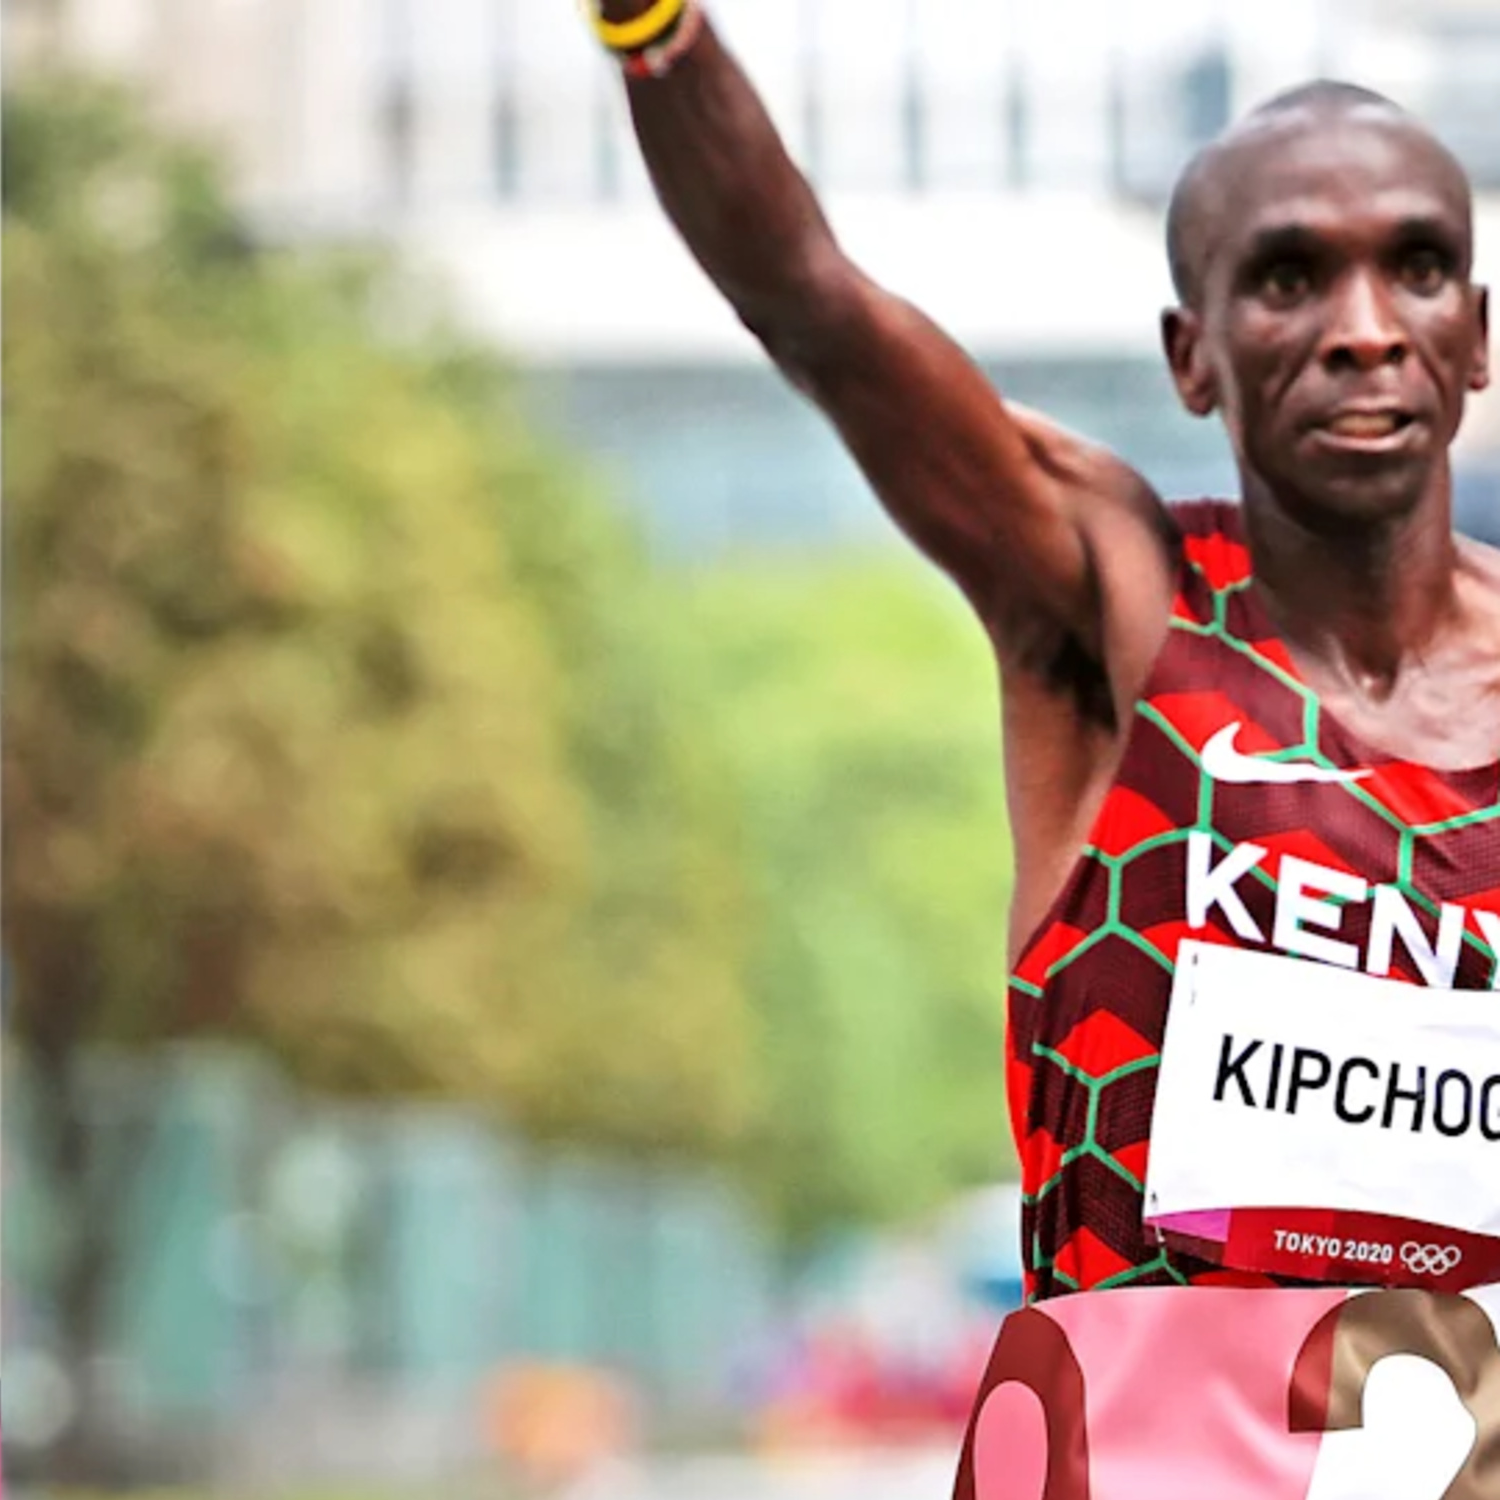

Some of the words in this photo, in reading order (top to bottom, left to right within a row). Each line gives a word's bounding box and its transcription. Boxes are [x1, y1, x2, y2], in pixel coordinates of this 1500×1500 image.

[1185, 830, 1500, 990] KEN
[1273, 1229, 1341, 1258] TOKYO
[1344, 1239, 1394, 1265] 2020
